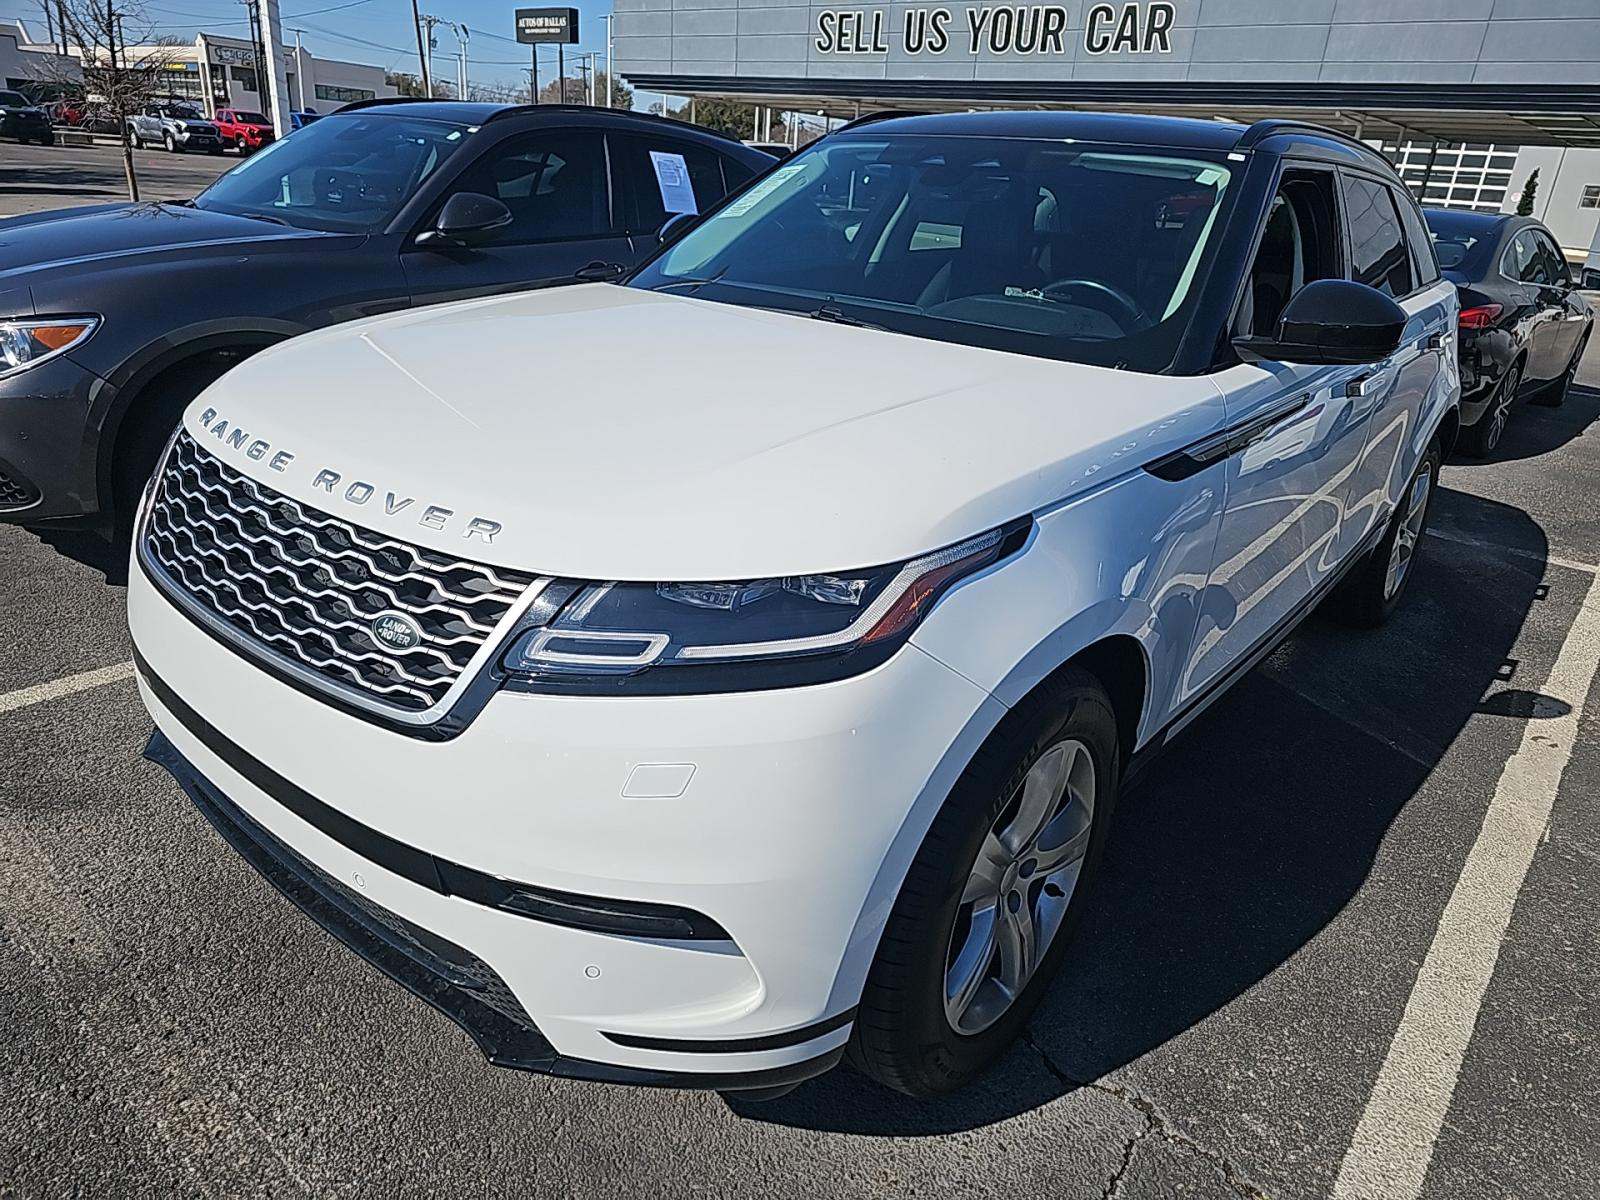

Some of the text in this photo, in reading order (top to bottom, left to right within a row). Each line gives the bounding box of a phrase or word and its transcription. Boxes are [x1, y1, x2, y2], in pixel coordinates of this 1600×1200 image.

[518, 16, 567, 27] AUTOS OF DALLAS
[815, 2, 1176, 55] SELL US YOUR CAR
[199, 407, 503, 545] RANGE ROVER
[382, 618, 407, 633] LAND
[381, 628, 411, 646] ROVER
